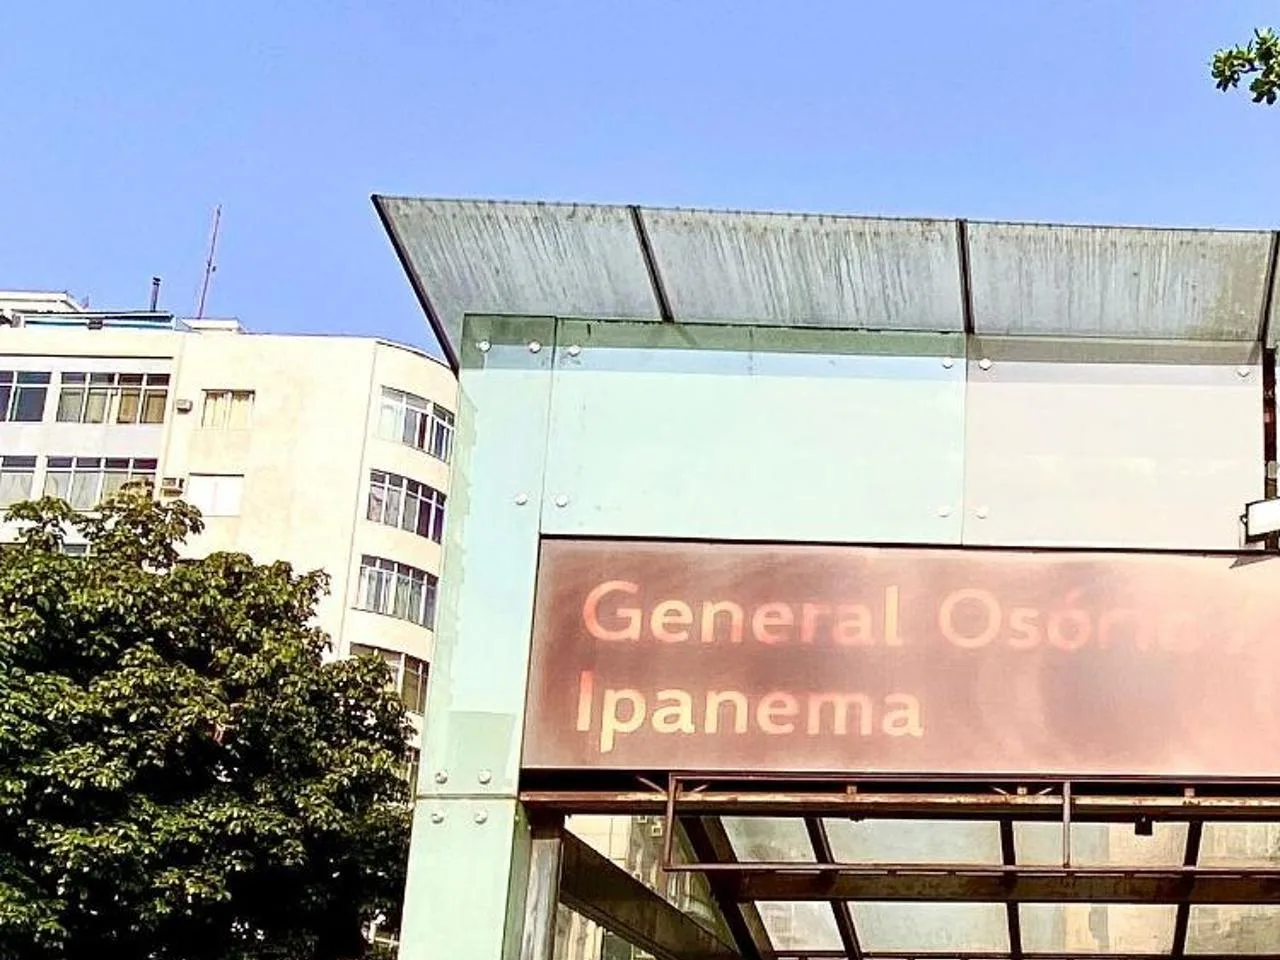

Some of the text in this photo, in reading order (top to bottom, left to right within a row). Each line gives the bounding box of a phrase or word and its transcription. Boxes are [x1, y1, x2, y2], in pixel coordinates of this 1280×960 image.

[583, 580, 1202, 652] General Osór
[576, 670, 924, 753] Ipanema
